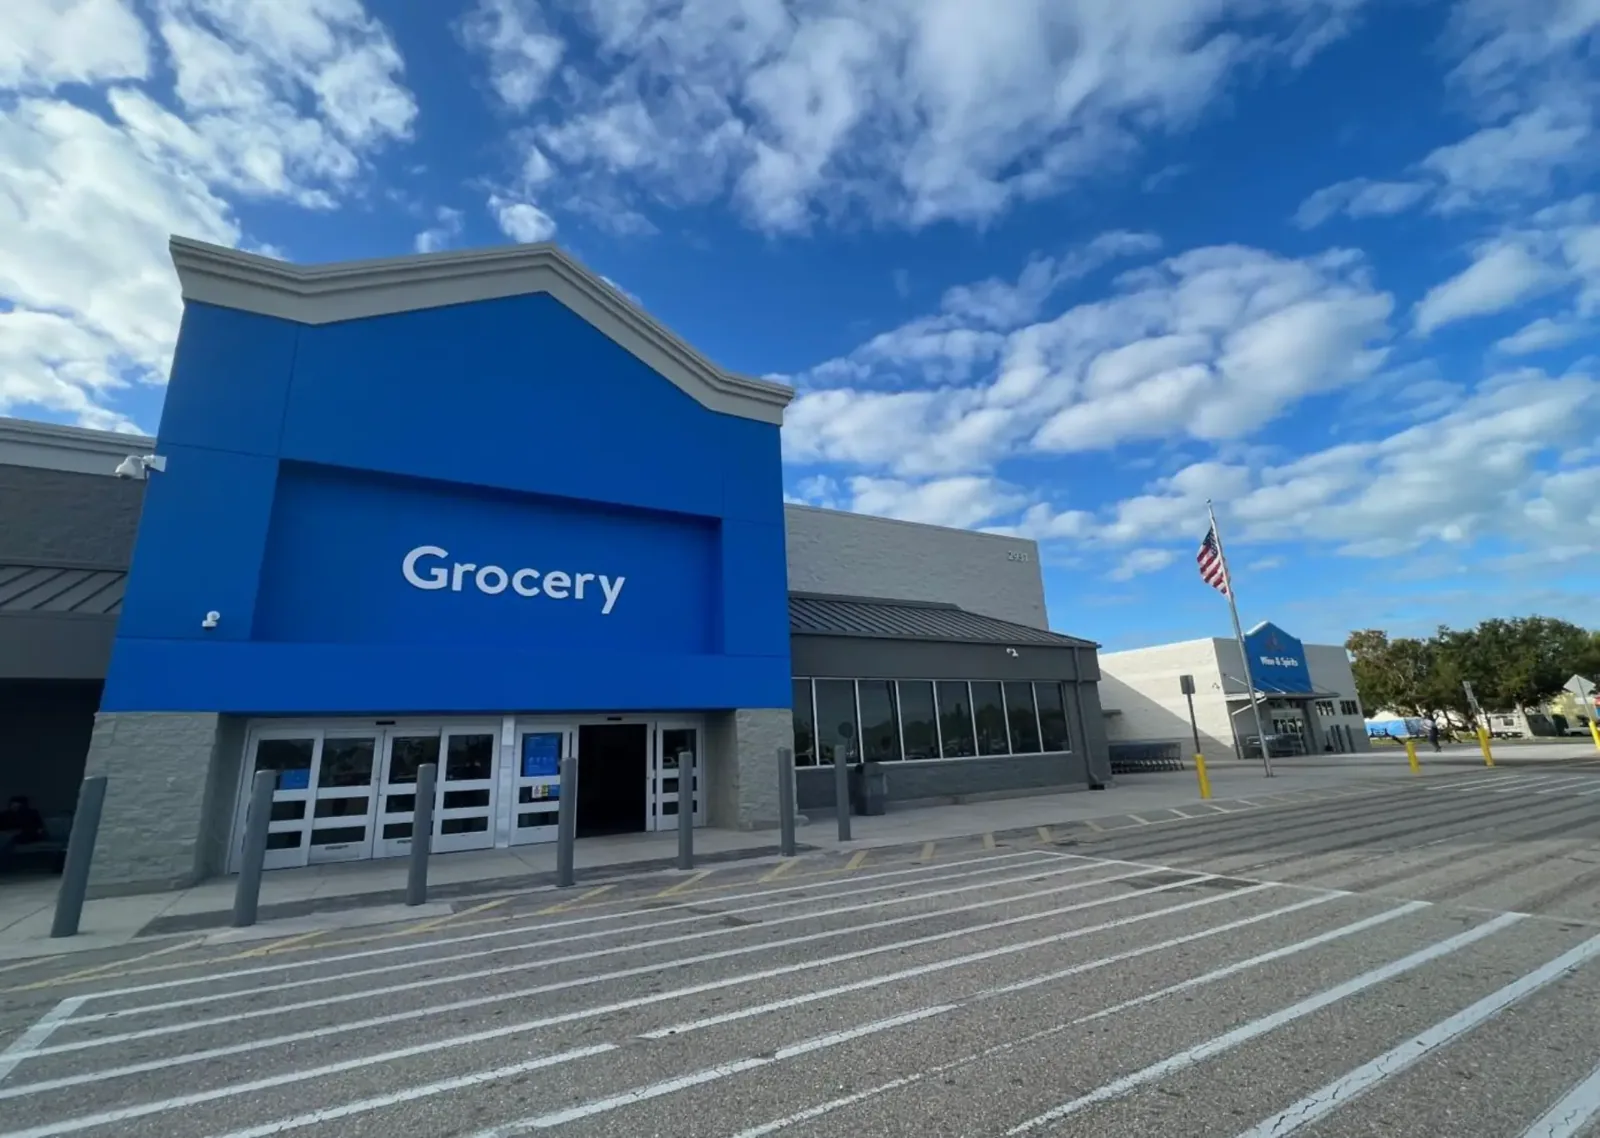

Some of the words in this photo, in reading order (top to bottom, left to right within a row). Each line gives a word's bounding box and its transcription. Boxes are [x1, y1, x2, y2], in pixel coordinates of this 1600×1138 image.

[402, 545, 626, 615] Grocery
[1259, 655, 1275, 665] Wine
[1280, 656, 1299, 668] Spirits
